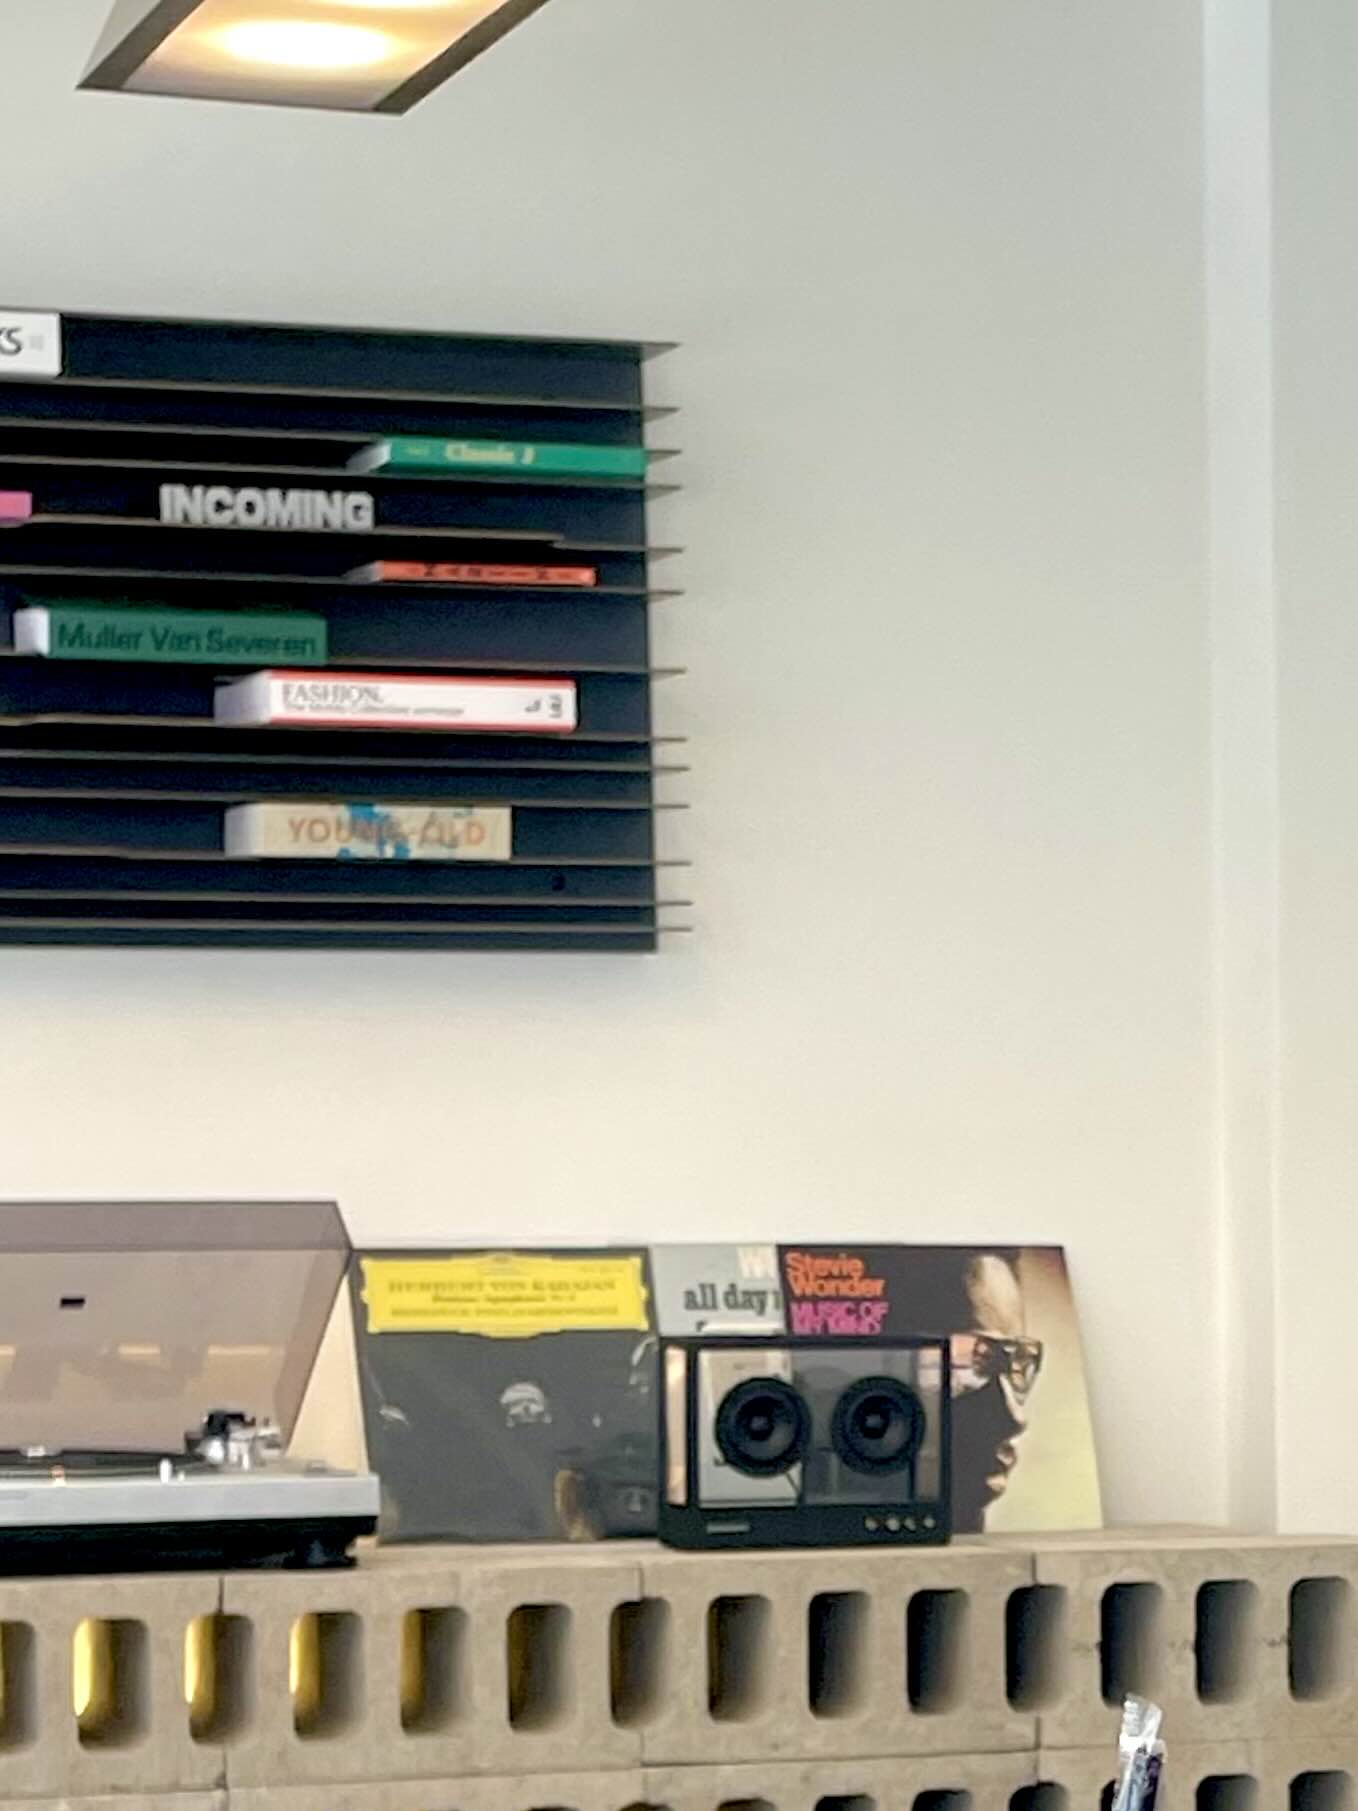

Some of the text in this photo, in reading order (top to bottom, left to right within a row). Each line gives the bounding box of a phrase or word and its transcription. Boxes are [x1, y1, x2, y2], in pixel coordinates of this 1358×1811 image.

[159, 485, 375, 530] INCOMING
[151, 626, 201, 650] Van
[205, 627, 317, 656] Severen
[784, 1251, 865, 1279] Stevie
[684, 1282, 718, 1311] all
[723, 1283, 768, 1316] day
[788, 1275, 886, 1297] Wonder
